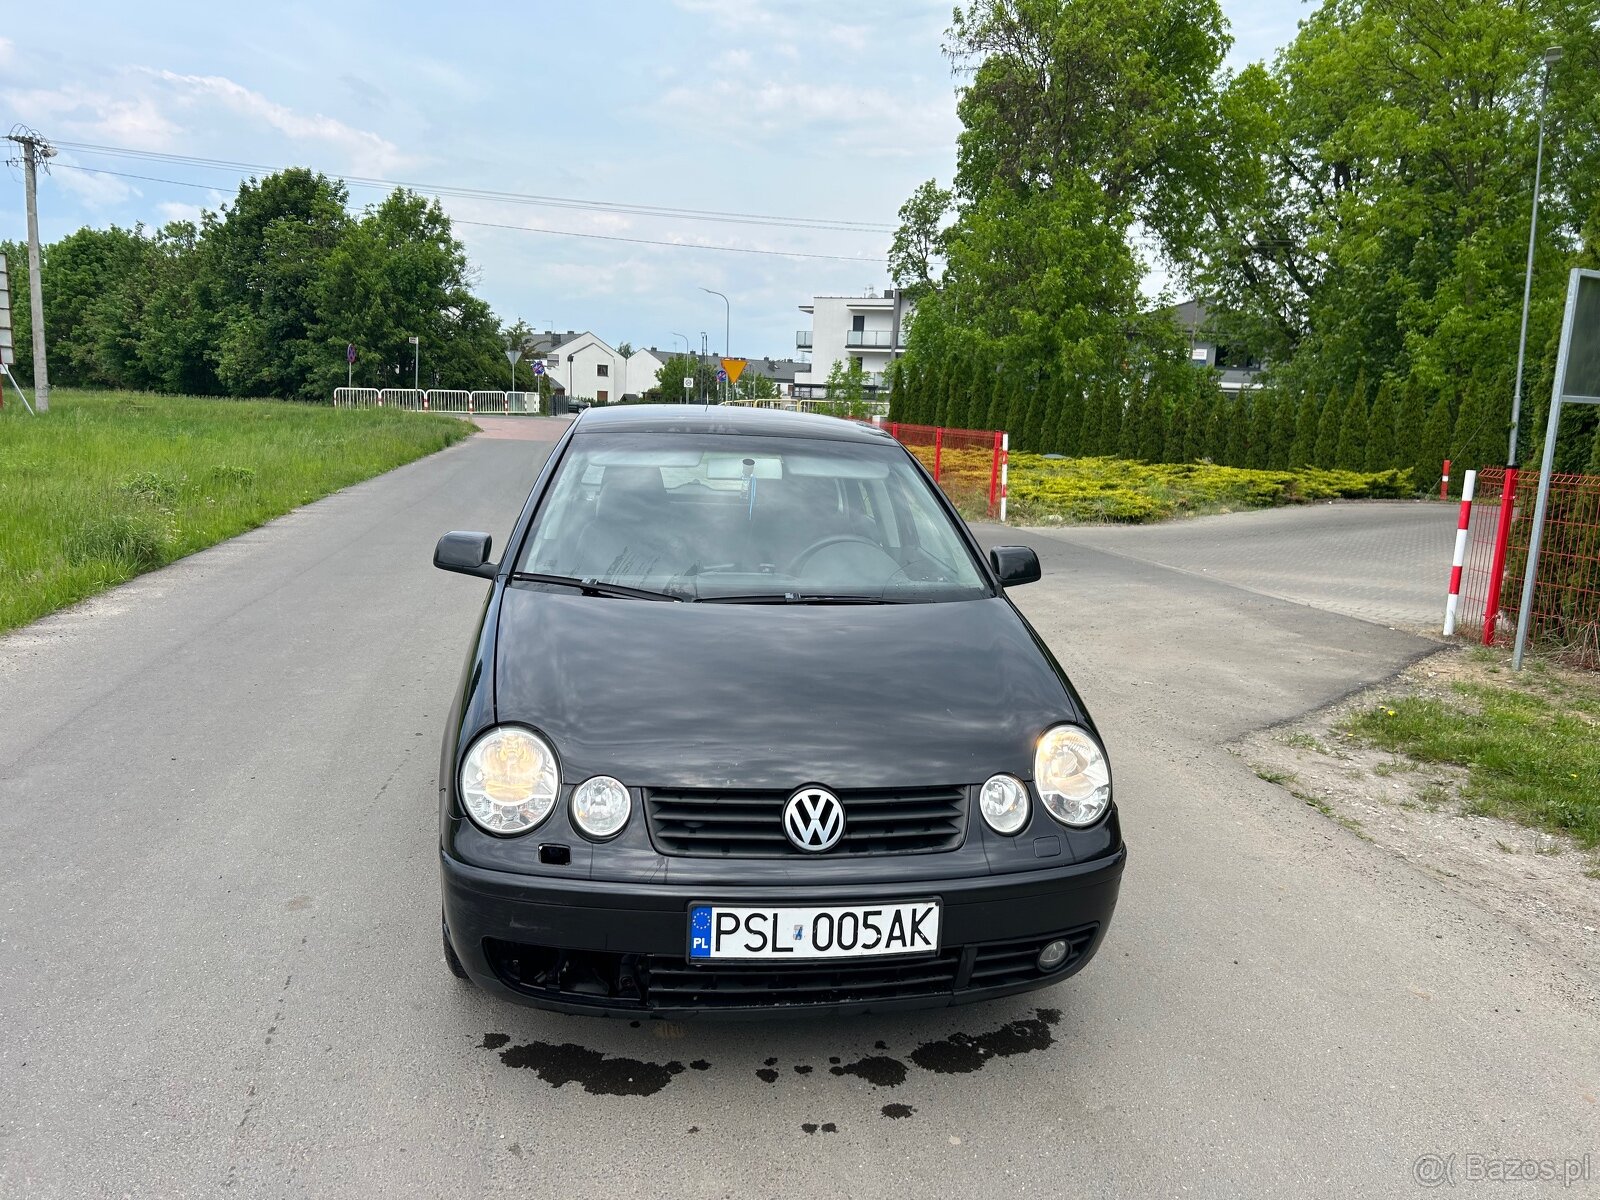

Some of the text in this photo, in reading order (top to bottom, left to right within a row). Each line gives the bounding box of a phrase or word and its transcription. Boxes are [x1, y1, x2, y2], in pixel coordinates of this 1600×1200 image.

[785, 789, 844, 851] VW
[693, 937, 709, 949] PL
[715, 906, 935, 953] PSL 005AK
